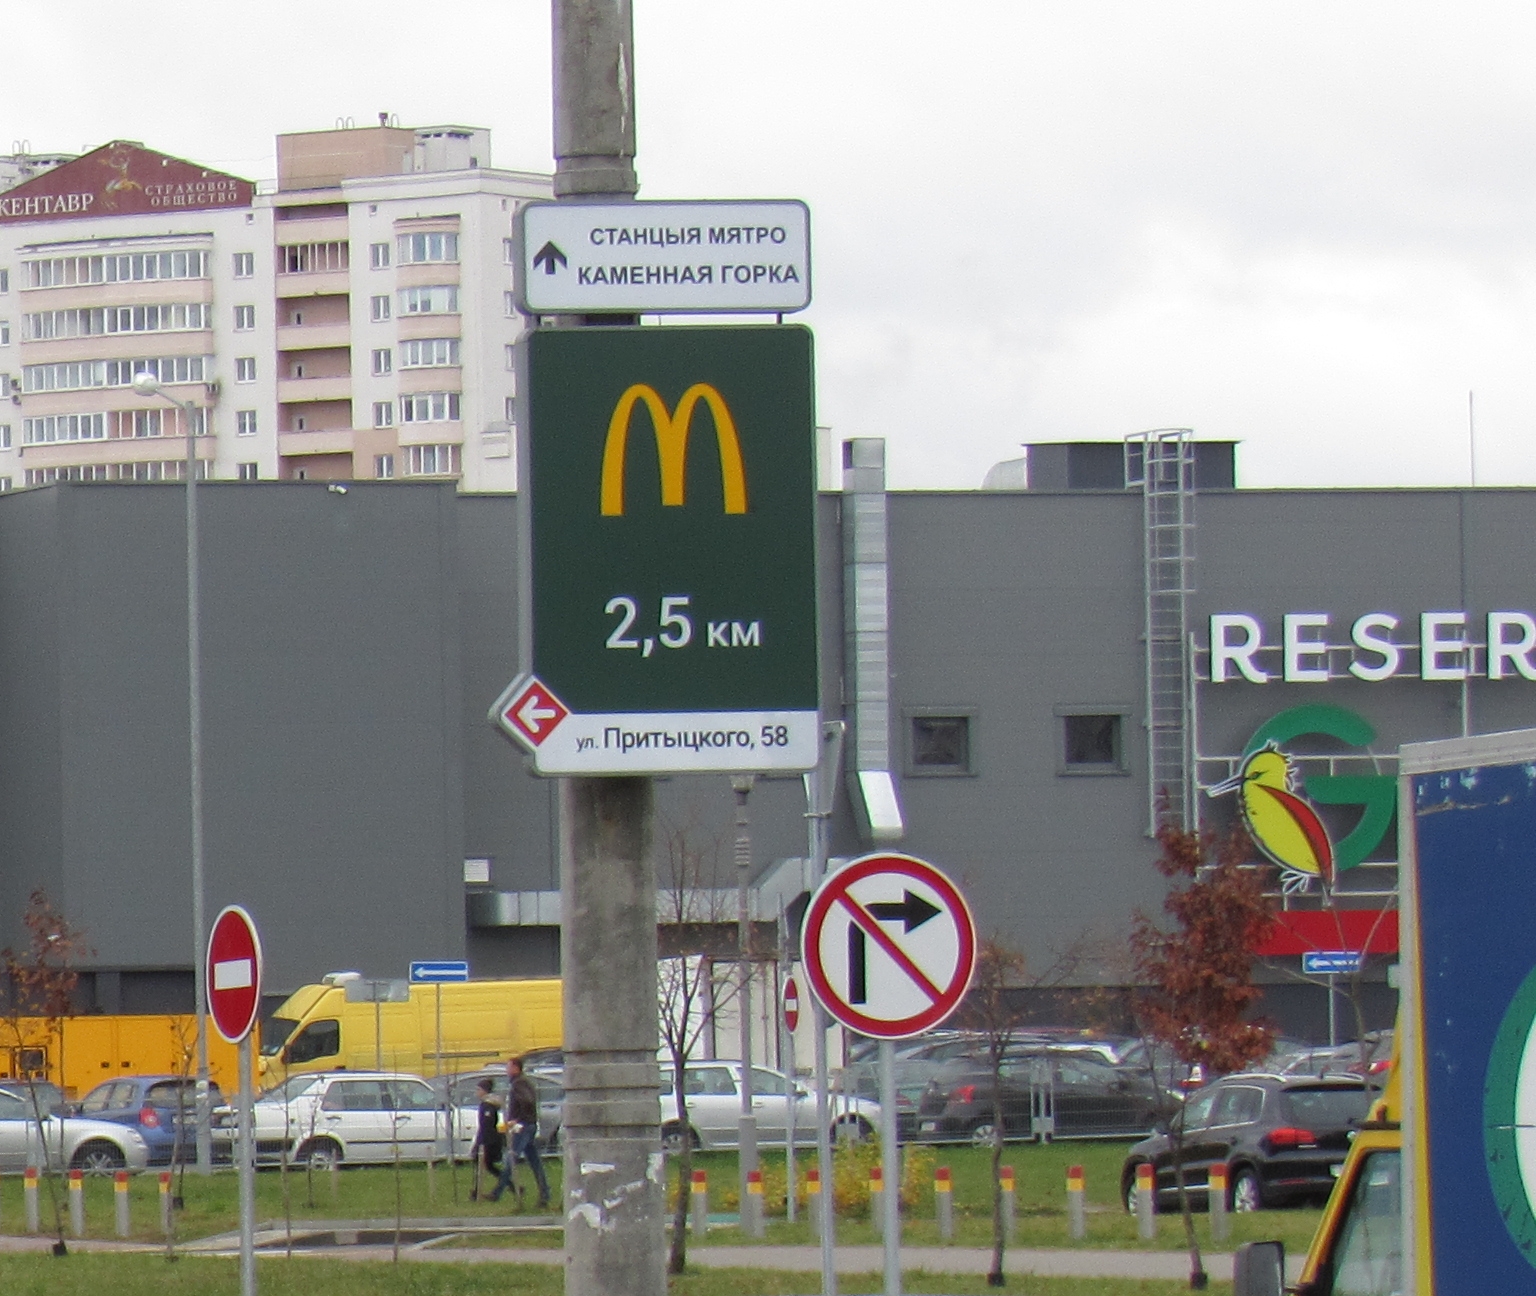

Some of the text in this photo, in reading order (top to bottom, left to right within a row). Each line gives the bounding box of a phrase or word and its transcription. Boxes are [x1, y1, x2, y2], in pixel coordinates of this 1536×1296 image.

[145, 180, 237, 196] СТРАХОВОЕ
[151, 192, 237, 207] ОБЩЕСТВО
[590, 226, 786, 247] СТАНЦЫЯ МЯТРО
[578, 264, 799, 285] КАМЕННАЯ ГОРКА
[604, 596, 761, 658] 2,5 км
[1209, 612, 1536, 684] RESER
[576, 725, 789, 753] ул. Притыцкого, 58
